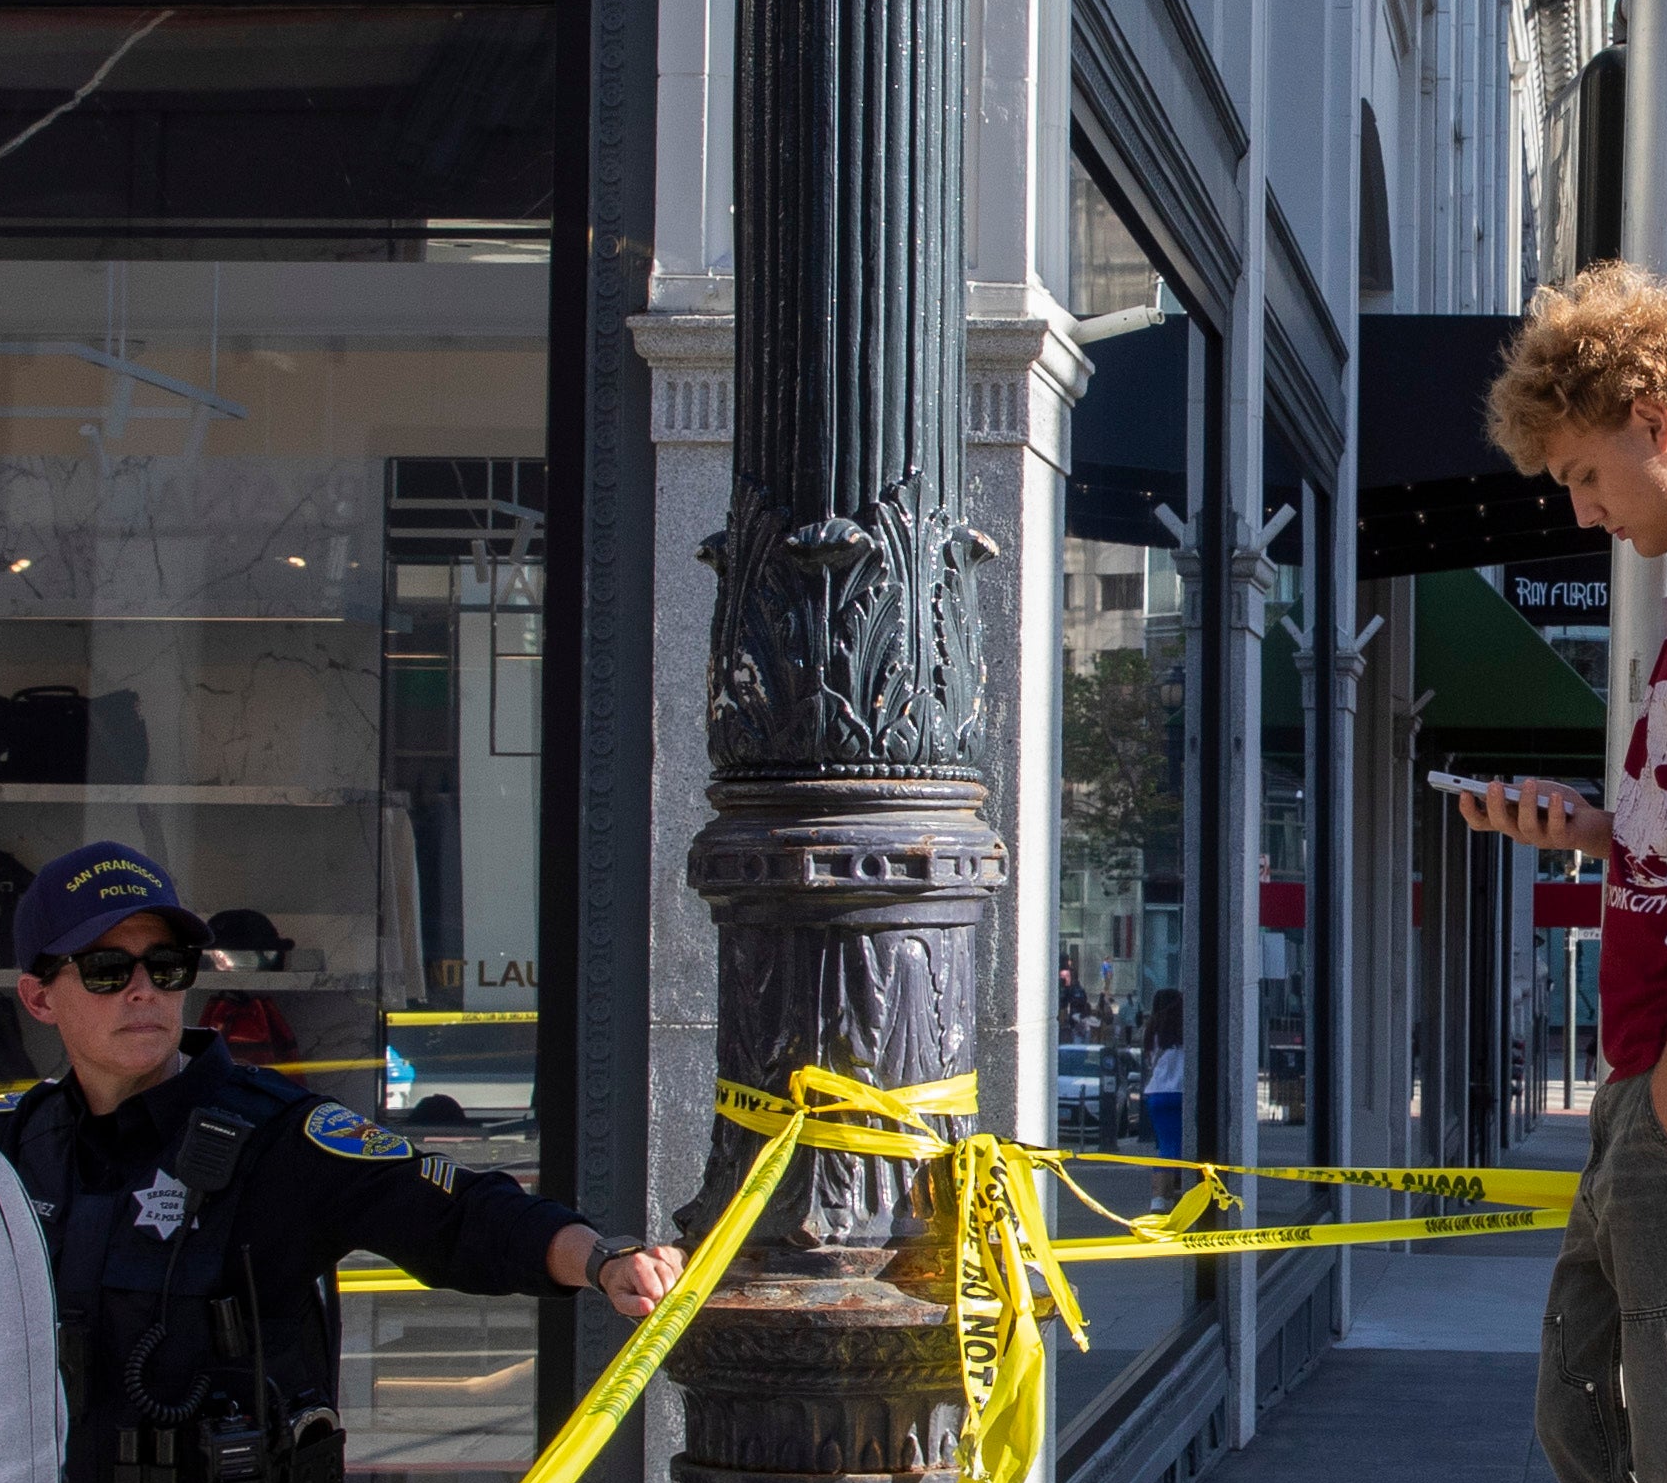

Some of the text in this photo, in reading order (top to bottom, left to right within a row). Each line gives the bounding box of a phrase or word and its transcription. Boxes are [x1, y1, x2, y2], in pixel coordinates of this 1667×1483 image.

[1516, 578, 1548, 607] RAY
[66, 859, 163, 892] SAN FRANCISCO
[100, 884, 148, 899] POLICE
[961, 1314, 999, 1387] NOT
